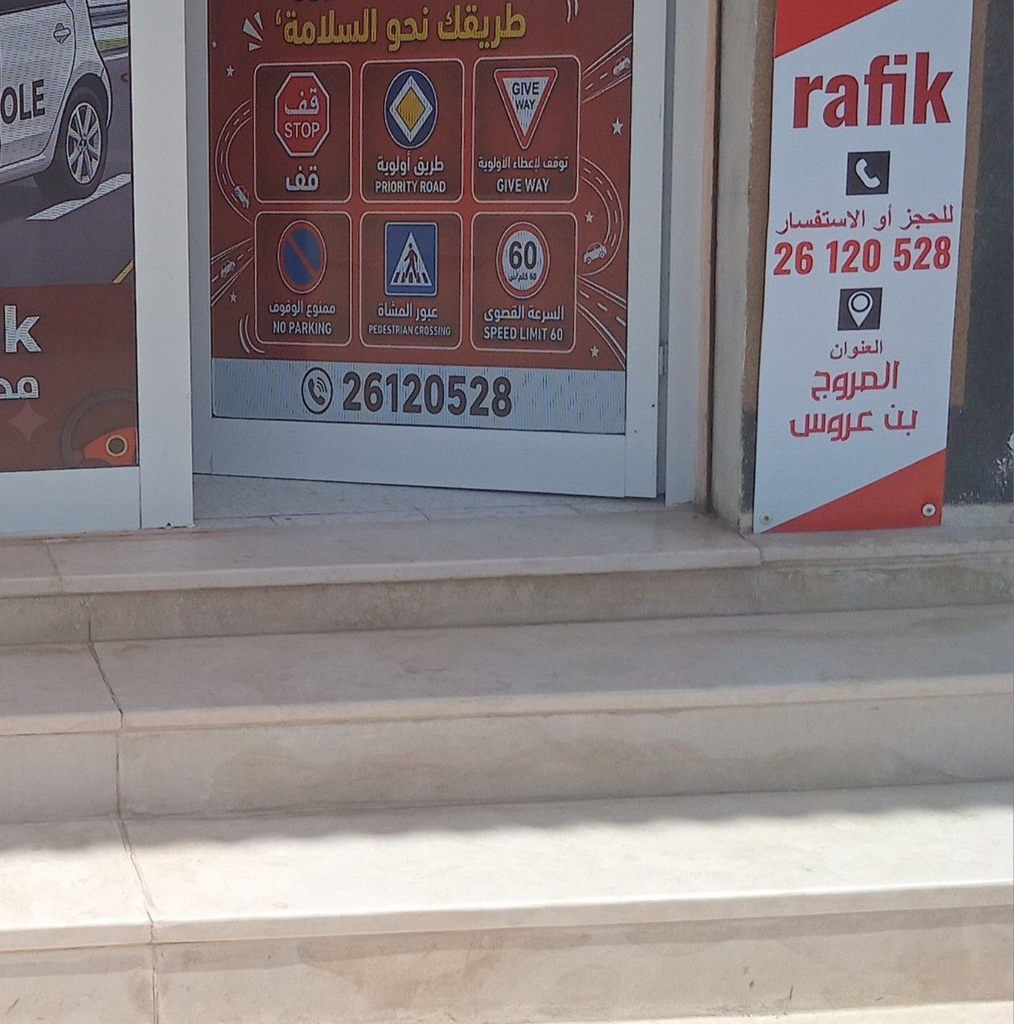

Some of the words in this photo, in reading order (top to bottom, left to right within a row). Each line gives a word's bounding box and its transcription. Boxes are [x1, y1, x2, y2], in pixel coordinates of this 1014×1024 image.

[387, 6, 429, 52] نحو
[438, 3, 527, 49] طريقك
[511, 83, 539, 96] GIVE
[793, 52, 953, 129] rafik
[285, 89, 319, 116] قف
[515, 98, 535, 111] WAY
[285, 122, 320, 138] STOP
[377, 150, 411, 176] أولوية
[413, 155, 444, 176] طريق
[478, 154, 510, 172] الأولوية
[543, 156, 569, 172] توقف
[286, 166, 318, 193] قف
[375, 181, 418, 193] PRIORITY
[420, 181, 446, 193] ROAD
[497, 178, 522, 193] GIVE
[525, 178, 550, 192] WAY
[776, 210, 865, 234] الاستفسار
[873, 205, 892, 231] أو
[901, 205, 953, 231] للحجز
[509, 241, 537, 270] 60
[773, 241, 814, 275] 26
[826, 239, 881, 274] 120
[894, 236, 952, 271] 528
[306, 301, 336, 318] ممنوع
[377, 301, 412, 317] المشاة
[416, 307, 438, 322] عبور
[484, 305, 525, 322] القصوى
[528, 305, 564, 323] السرعة
[273, 322, 286, 334] NO
[289, 322, 332, 335] PARKING
[368, 325, 413, 335] PEDESTRIAN
[414, 326, 451, 336] CROSSING
[484, 326, 517, 339] SPEED
[520, 327, 548, 340] LIMIT
[550, 328, 563, 341] 60
[830, 340, 883, 360] العنوان
[811, 360, 899, 402] المروج
[342, 372, 512, 417] 26120528
[790, 410, 873, 442] عروس
[884, 404, 918, 436] بن
